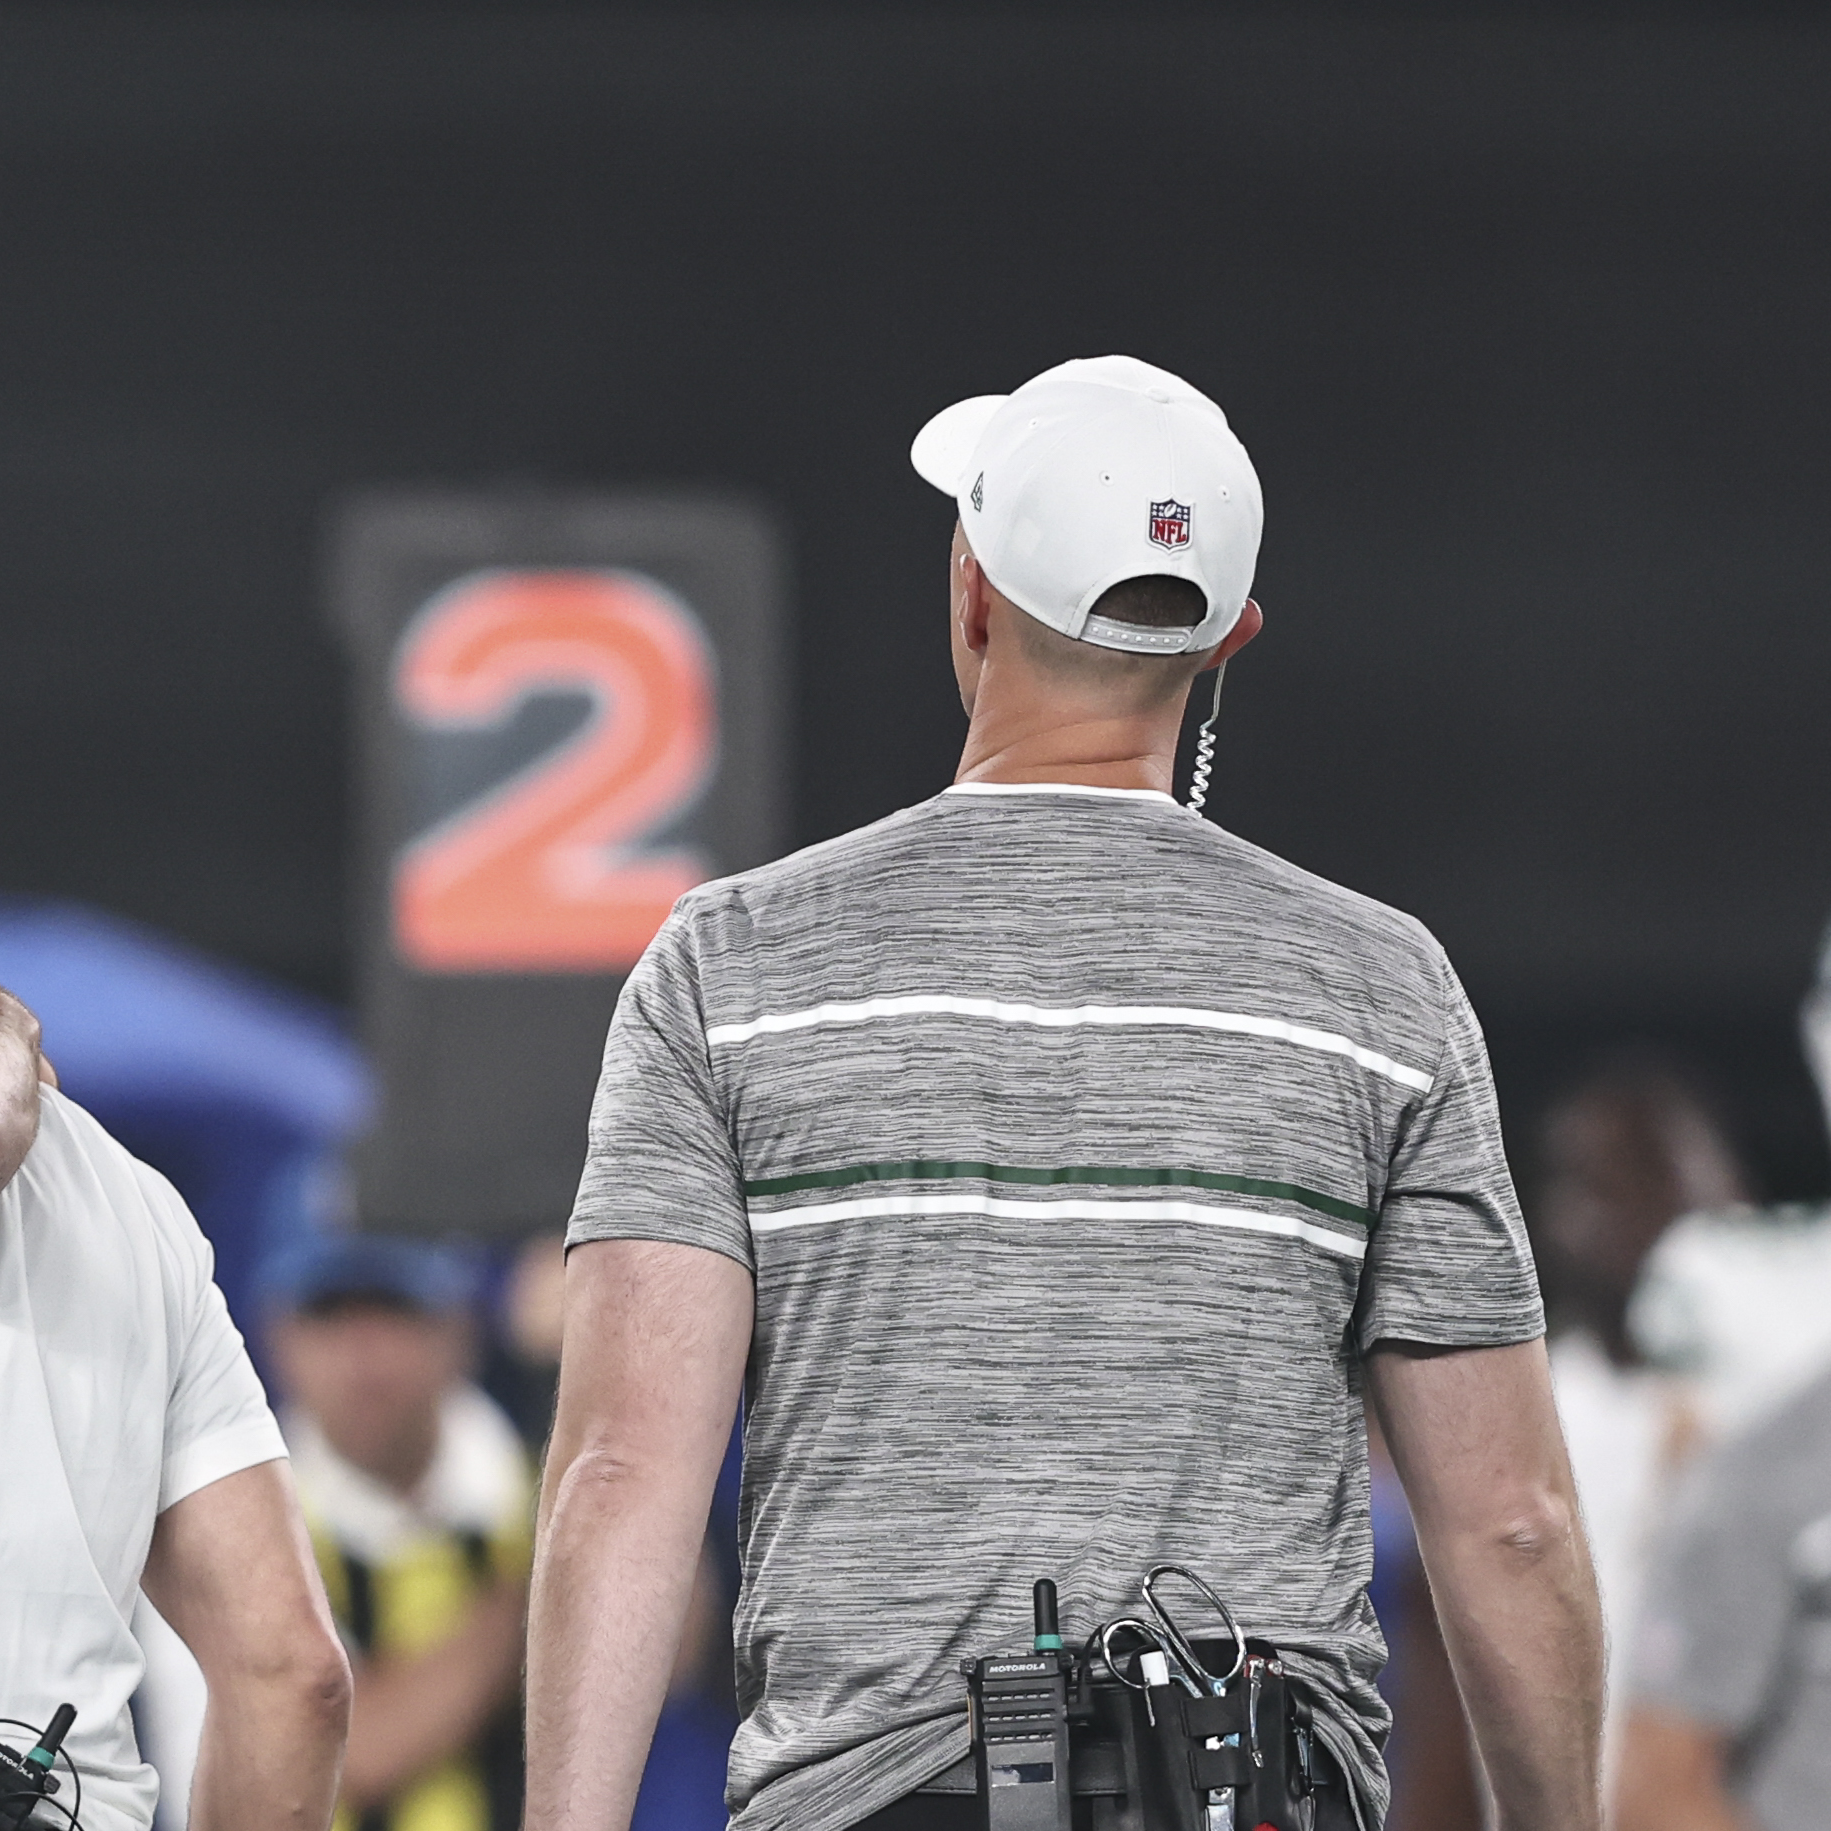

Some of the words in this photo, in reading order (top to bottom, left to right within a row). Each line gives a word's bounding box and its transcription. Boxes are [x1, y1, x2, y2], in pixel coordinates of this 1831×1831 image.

[1152, 518, 1187, 545] NFL
[393, 566, 719, 973] 2
[989, 1662, 1046, 1674] MOTOROLA
